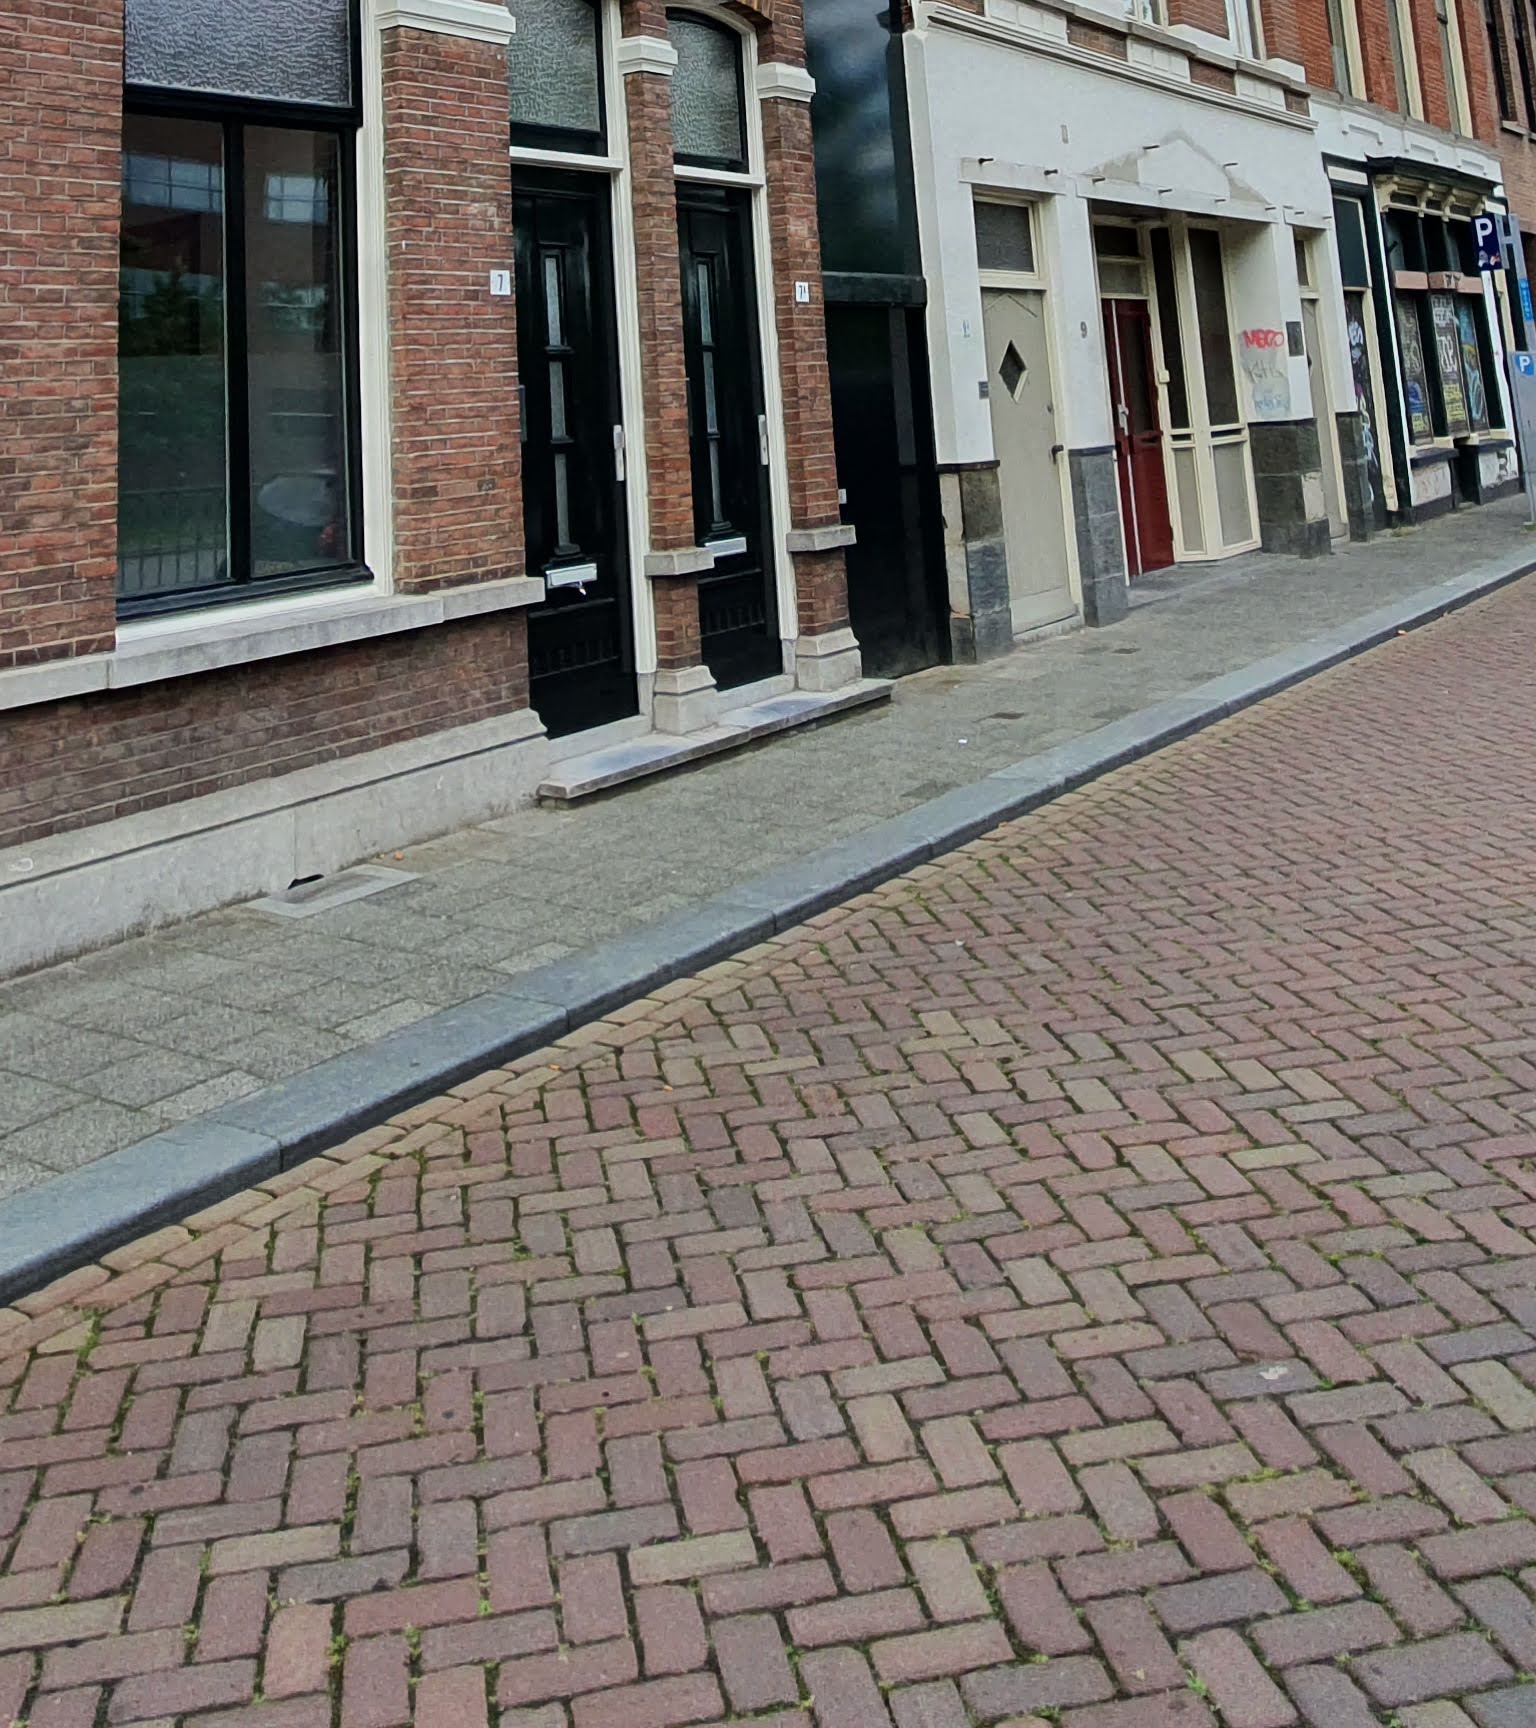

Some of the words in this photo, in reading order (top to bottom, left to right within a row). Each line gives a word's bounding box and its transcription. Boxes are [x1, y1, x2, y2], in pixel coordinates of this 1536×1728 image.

[1475, 218, 1493, 247] P
[497, 273, 504, 292] 7
[1080, 321, 1088, 339] 9
[1519, 355, 1531, 372] P
